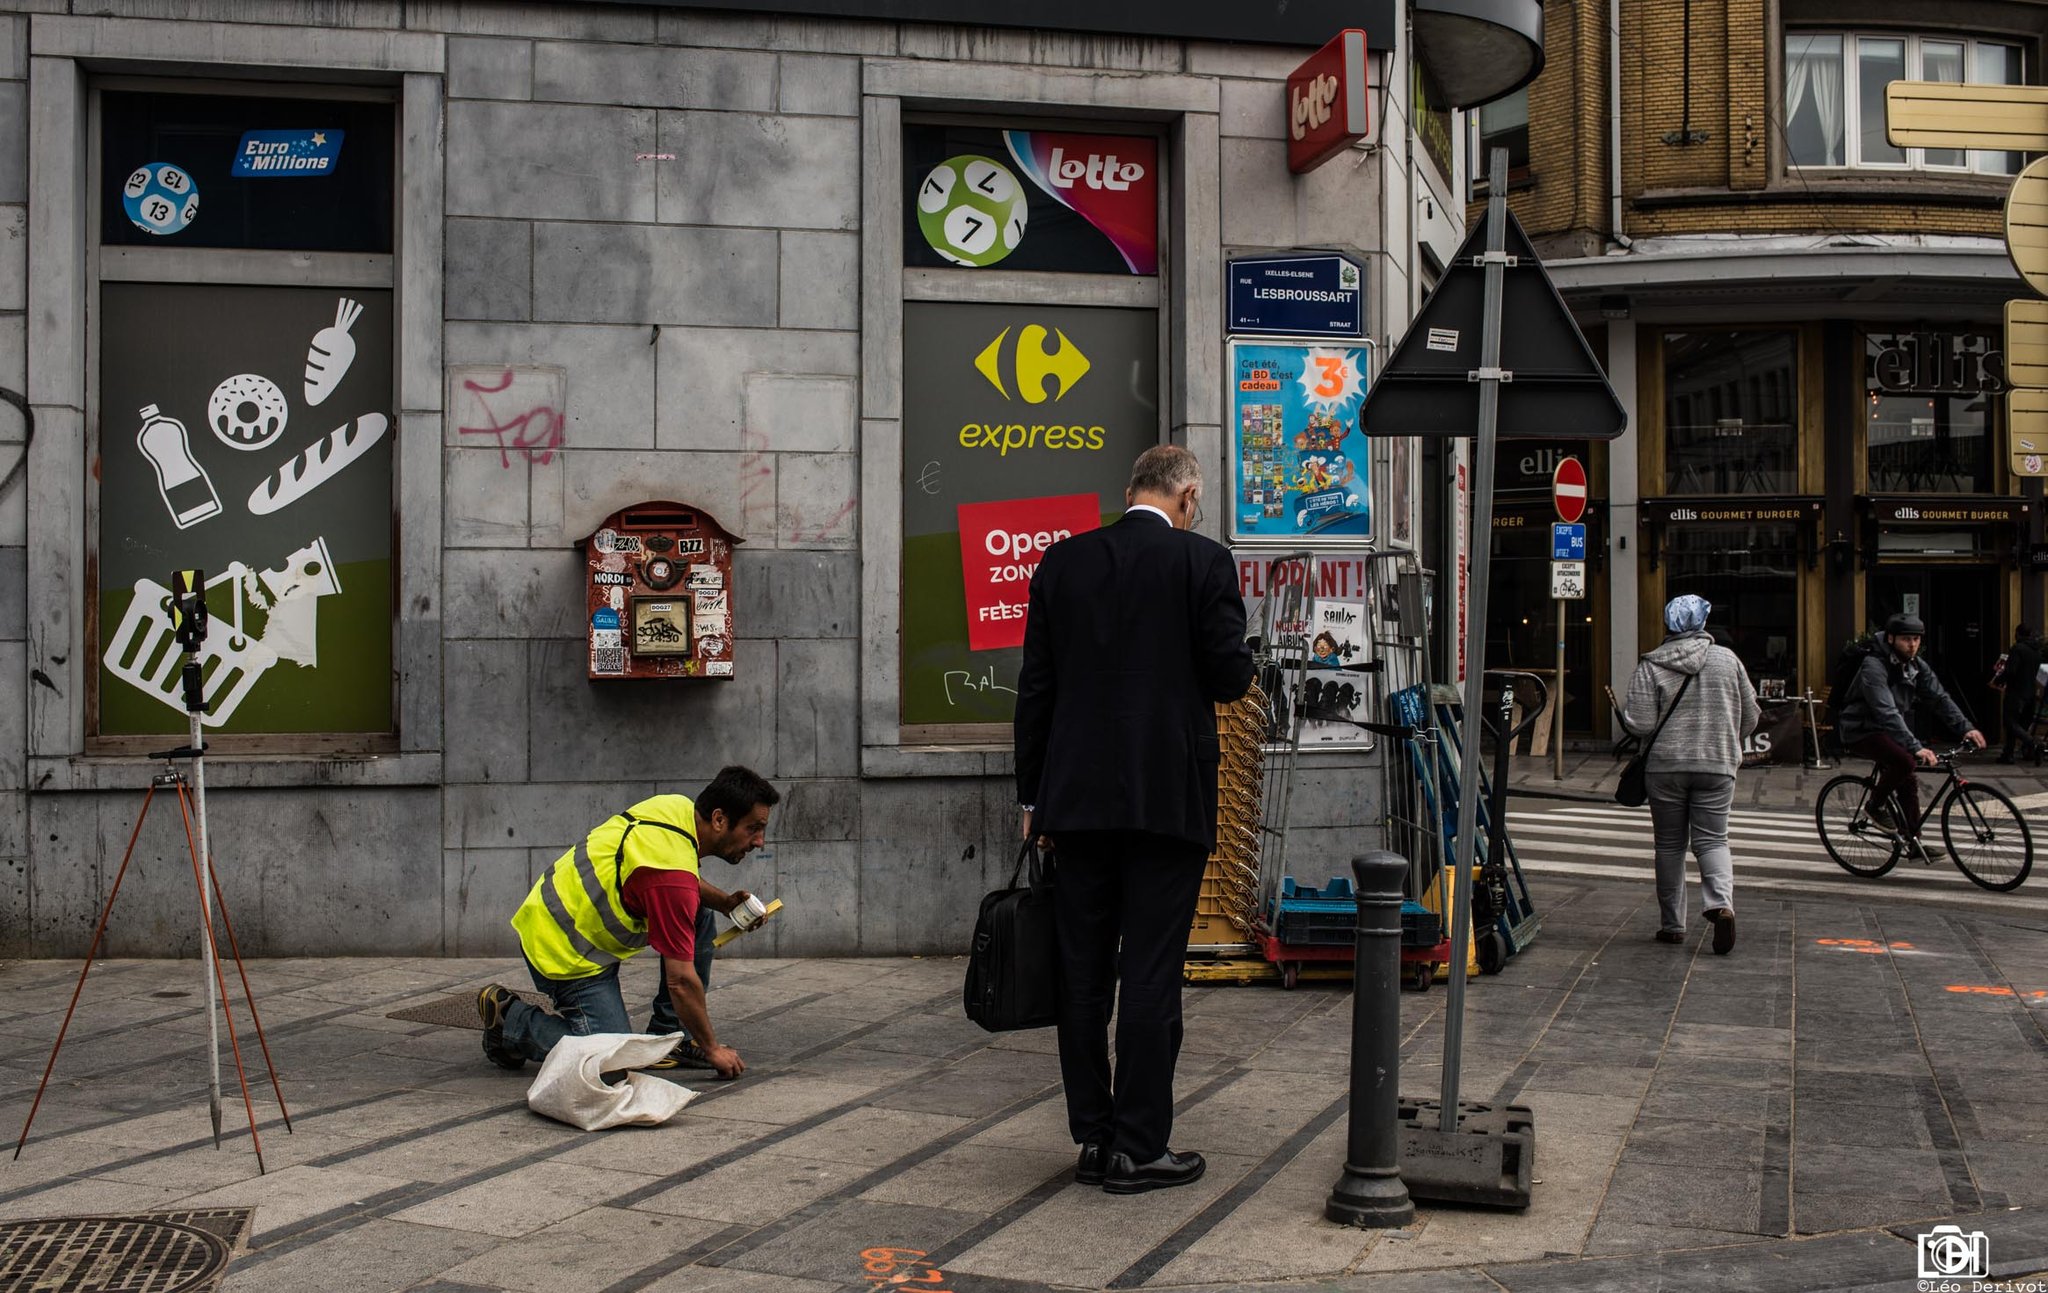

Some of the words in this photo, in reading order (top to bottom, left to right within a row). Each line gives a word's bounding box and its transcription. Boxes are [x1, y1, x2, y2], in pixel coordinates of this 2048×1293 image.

[245, 141, 289, 155] Euro
[251, 156, 329, 170] Millions
[149, 201, 169, 221] 13
[962, 216, 983, 243] 7
[1265, 270, 1314, 279] IXELLES-ELSENE
[1254, 288, 1353, 303] LESBROUSSART
[1241, 359, 1259, 369] Cet
[1261, 359, 1280, 370] été,
[1874, 332, 2007, 396] ellis
[1241, 370, 1250, 379] la
[1253, 370, 1268, 379] BD
[1270, 370, 1293, 380] c'est
[1241, 381, 1278, 390] cadeau
[959, 423, 1106, 456] express
[1670, 508, 1697, 520] ellis
[1701, 510, 1752, 520] GOURMET
[1757, 510, 1800, 519] BURGER
[1895, 507, 1919, 519] ellis
[1922, 510, 1967, 520] GOURMET
[1971, 511, 2009, 520] BURGER
[1493, 517, 1524, 527] RGER
[680, 539, 702, 553] BZZ
[985, 527, 1072, 560] Open
[1571, 536, 1583, 547] BUS
[1240, 561, 1350, 598] FLIPPANT
[1356, 561, 1363, 598] !
[978, 602, 1030, 621] FEEST
